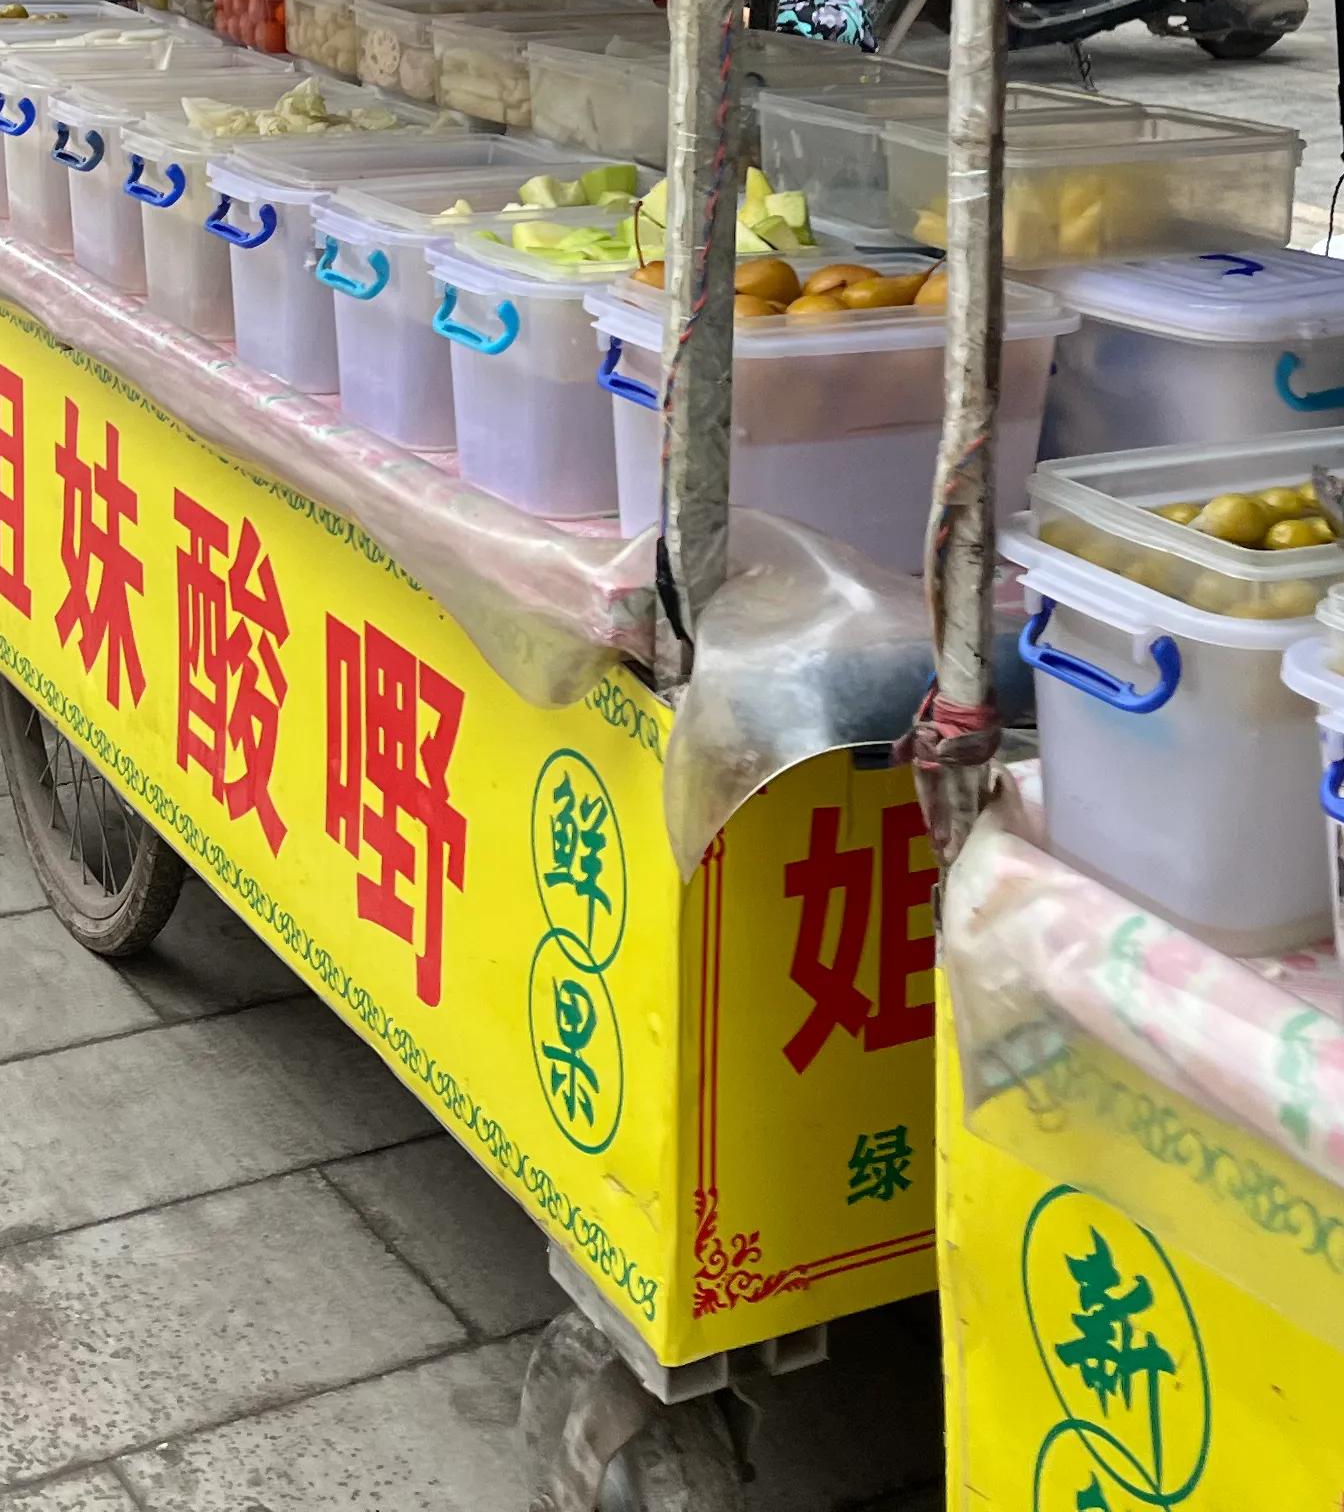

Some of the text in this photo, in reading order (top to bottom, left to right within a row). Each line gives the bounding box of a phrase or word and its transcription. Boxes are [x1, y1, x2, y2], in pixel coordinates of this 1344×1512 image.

[542, 771, 612, 1128] 鲜果
[781, 806, 936, 1076] 姐
[847, 1125, 913, 1206] 绿
[1056, 1226, 1175, 1512] 新
